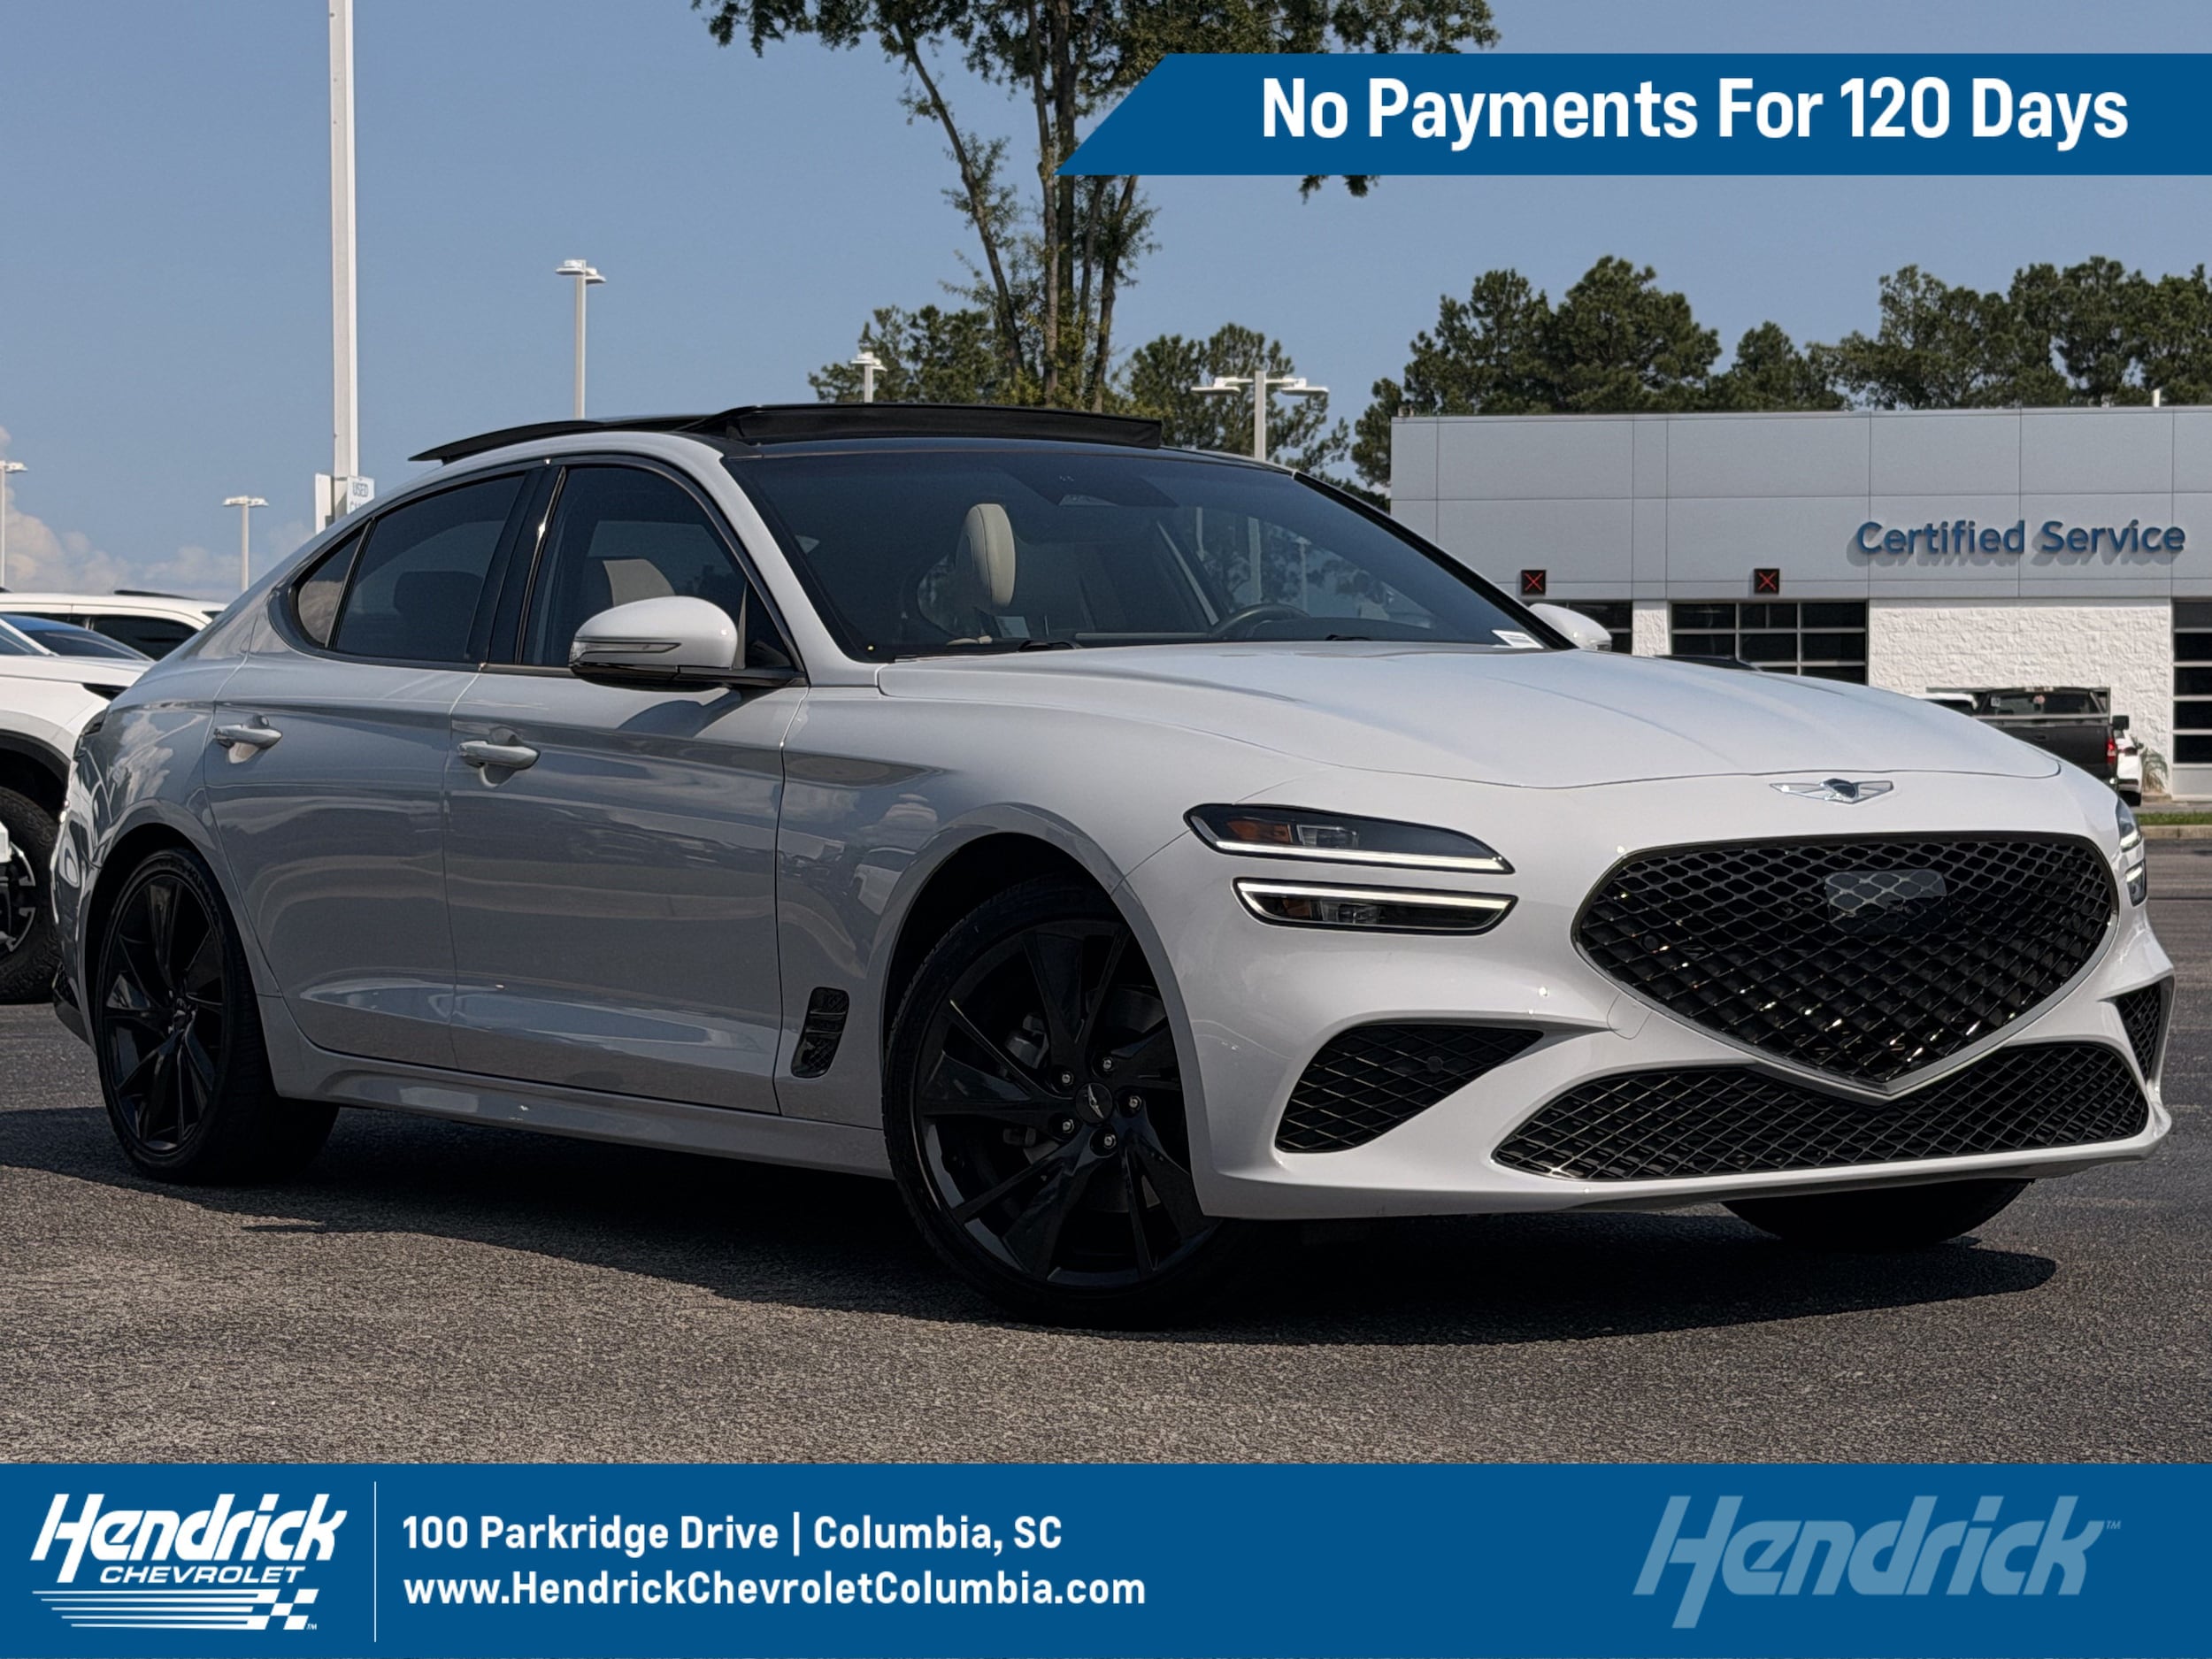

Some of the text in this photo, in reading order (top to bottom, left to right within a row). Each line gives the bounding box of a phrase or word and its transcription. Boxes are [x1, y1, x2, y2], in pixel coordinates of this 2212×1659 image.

[352, 482, 369, 497] USED
[1857, 518, 2185, 554] Certified Service
